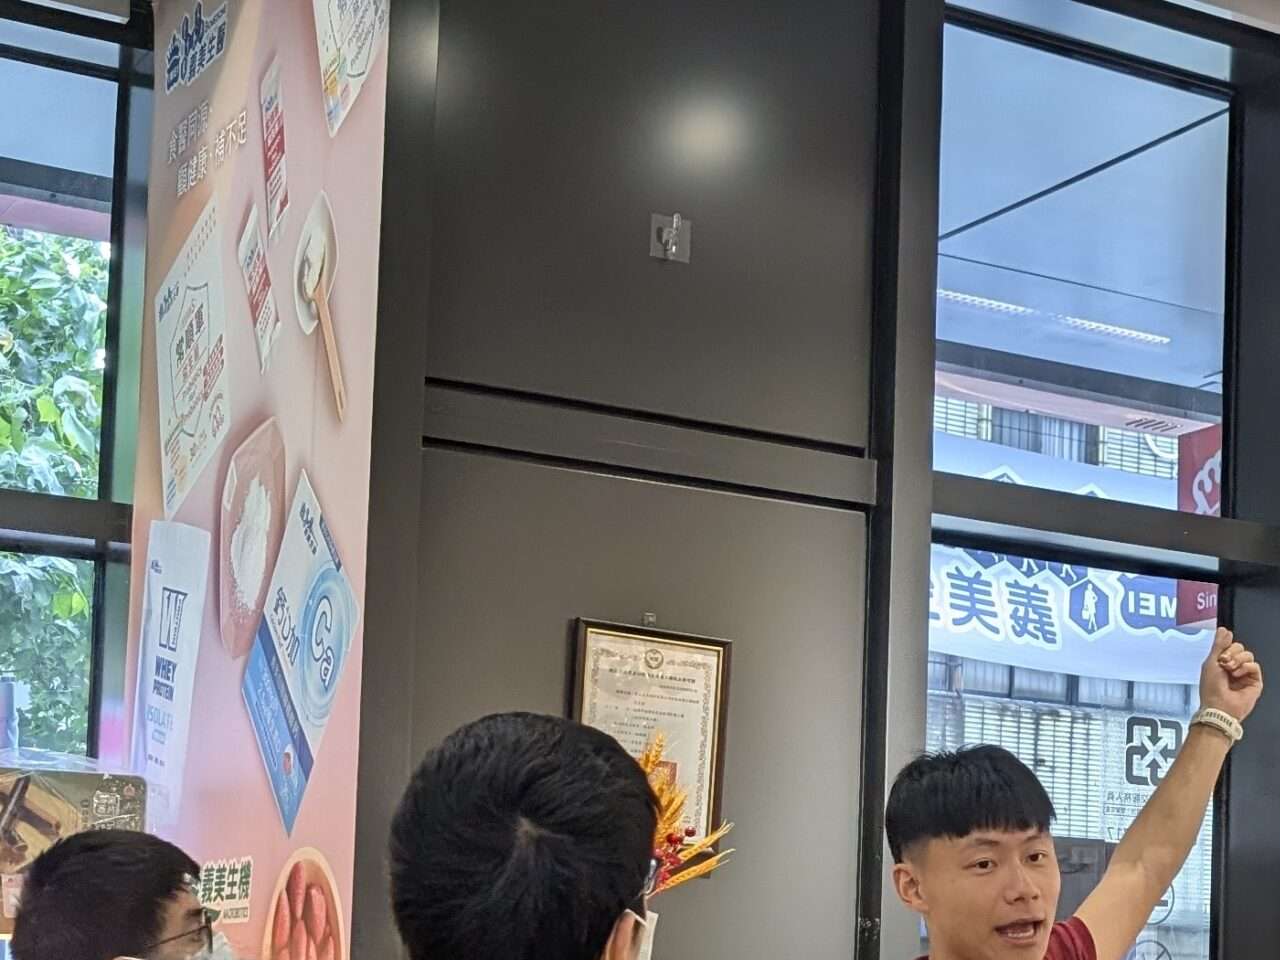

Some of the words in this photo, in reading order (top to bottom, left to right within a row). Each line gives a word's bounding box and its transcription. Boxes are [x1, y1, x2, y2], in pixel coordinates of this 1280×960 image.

[155, 656, 178, 684] WHEY
[153, 679, 175, 702] PROTEIN
[201, 862, 252, 904] 義美生機
